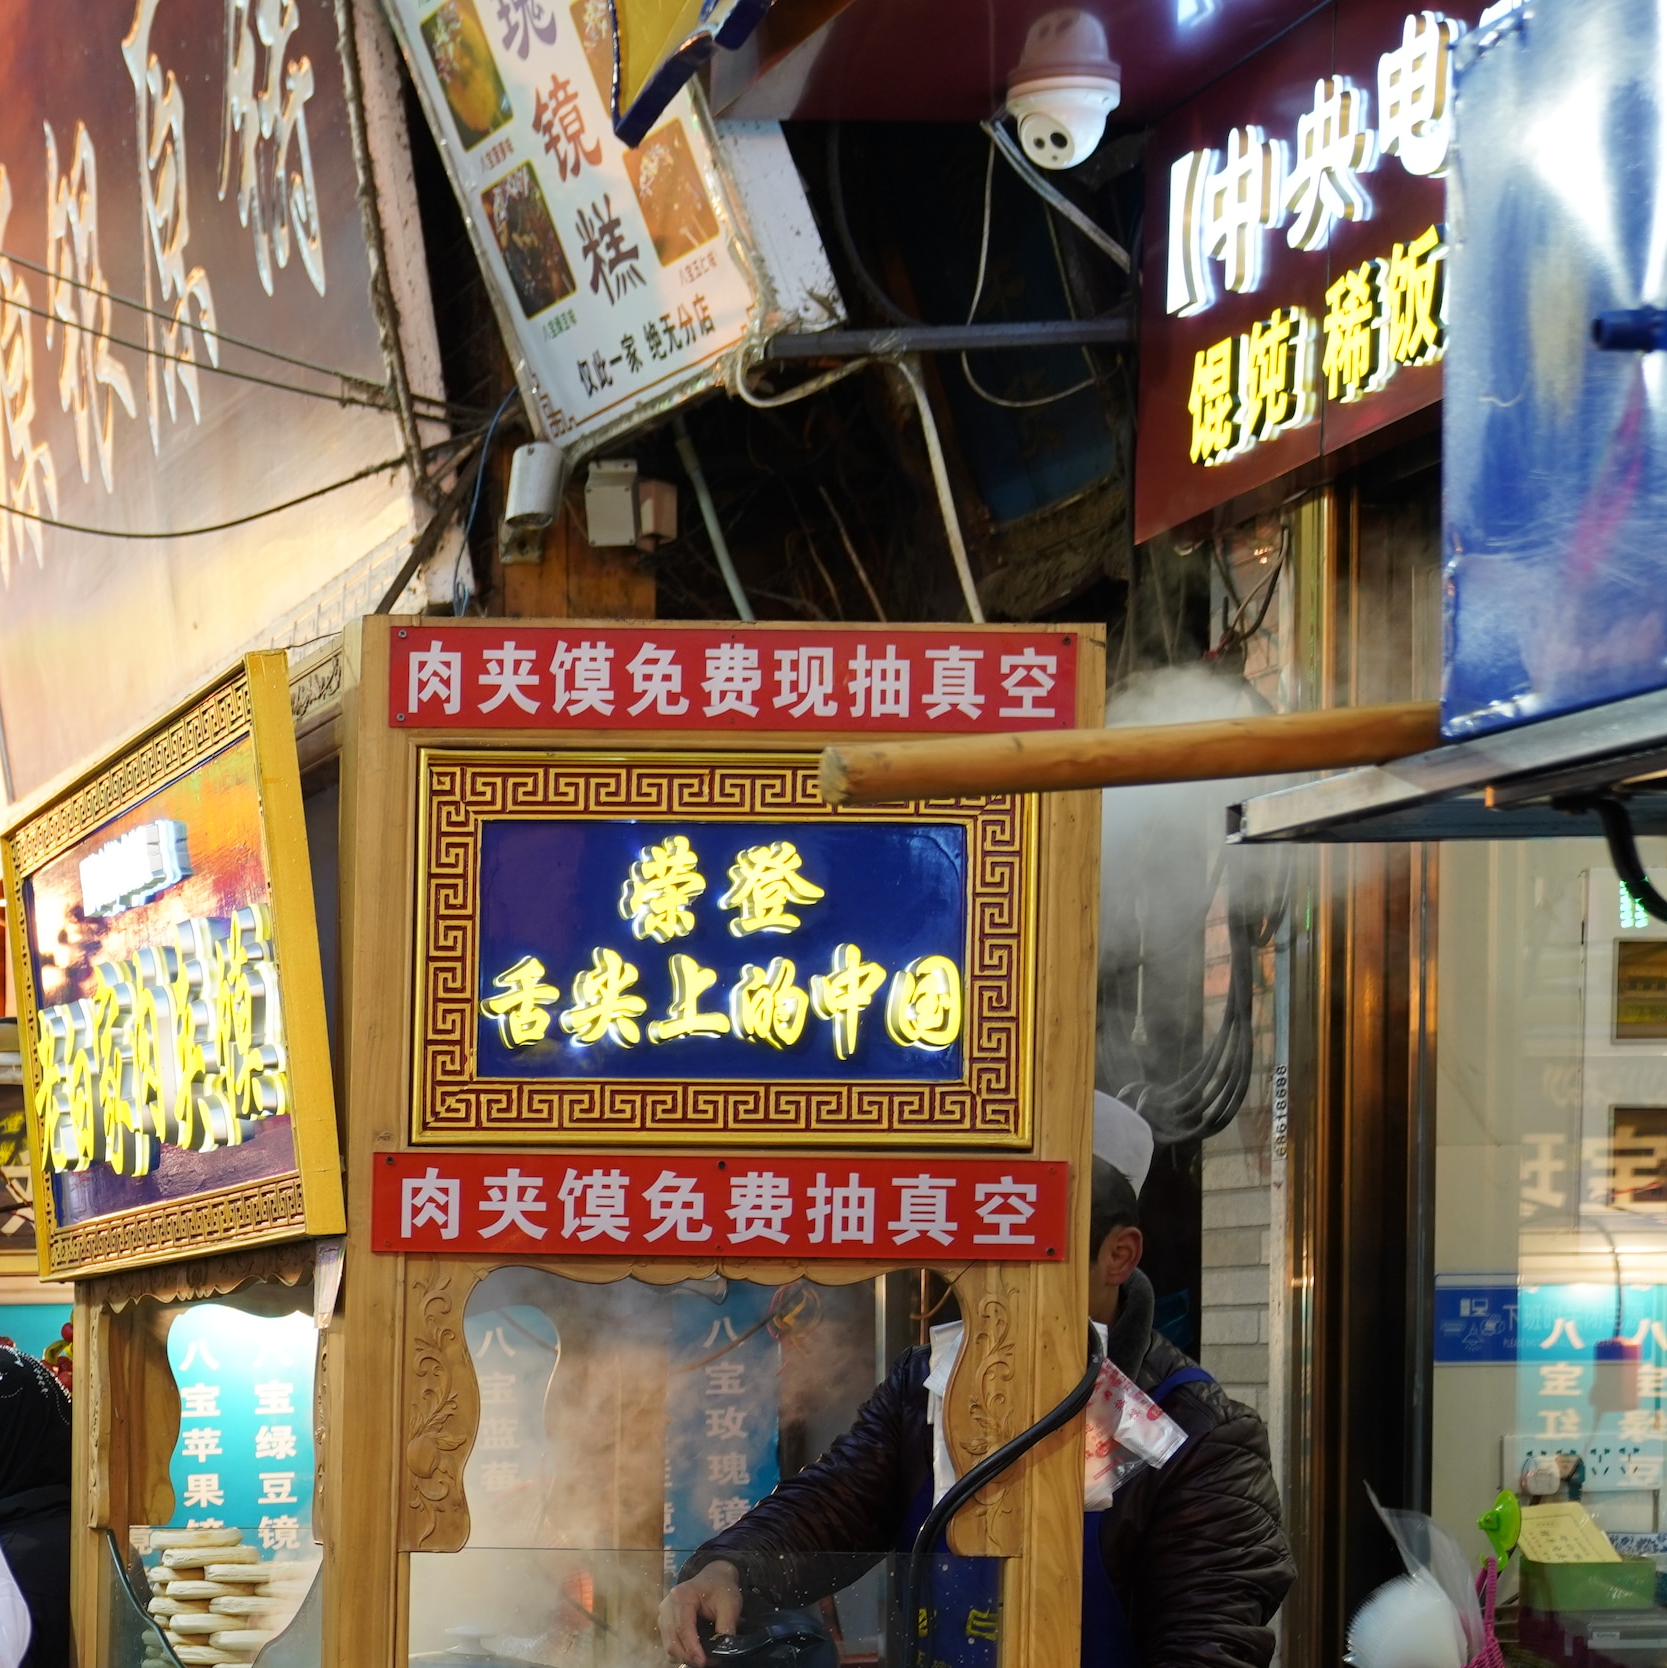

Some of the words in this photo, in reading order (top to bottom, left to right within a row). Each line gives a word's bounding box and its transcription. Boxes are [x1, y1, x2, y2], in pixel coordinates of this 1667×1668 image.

[576, 332, 644, 399] 仅此一家
[642, 292, 716, 361] 绝无分店
[405, 638, 1059, 721] 肉夹馍免费现抽真空
[619, 834, 826, 945] 荣登
[480, 941, 963, 1061] 舌尖上的中国
[1275, 1064, 1288, 1157] 68618688
[398, 1165, 1039, 1248] 肉夹馍免费抽真空
[178, 1338, 226, 1530] 八宝苹果
